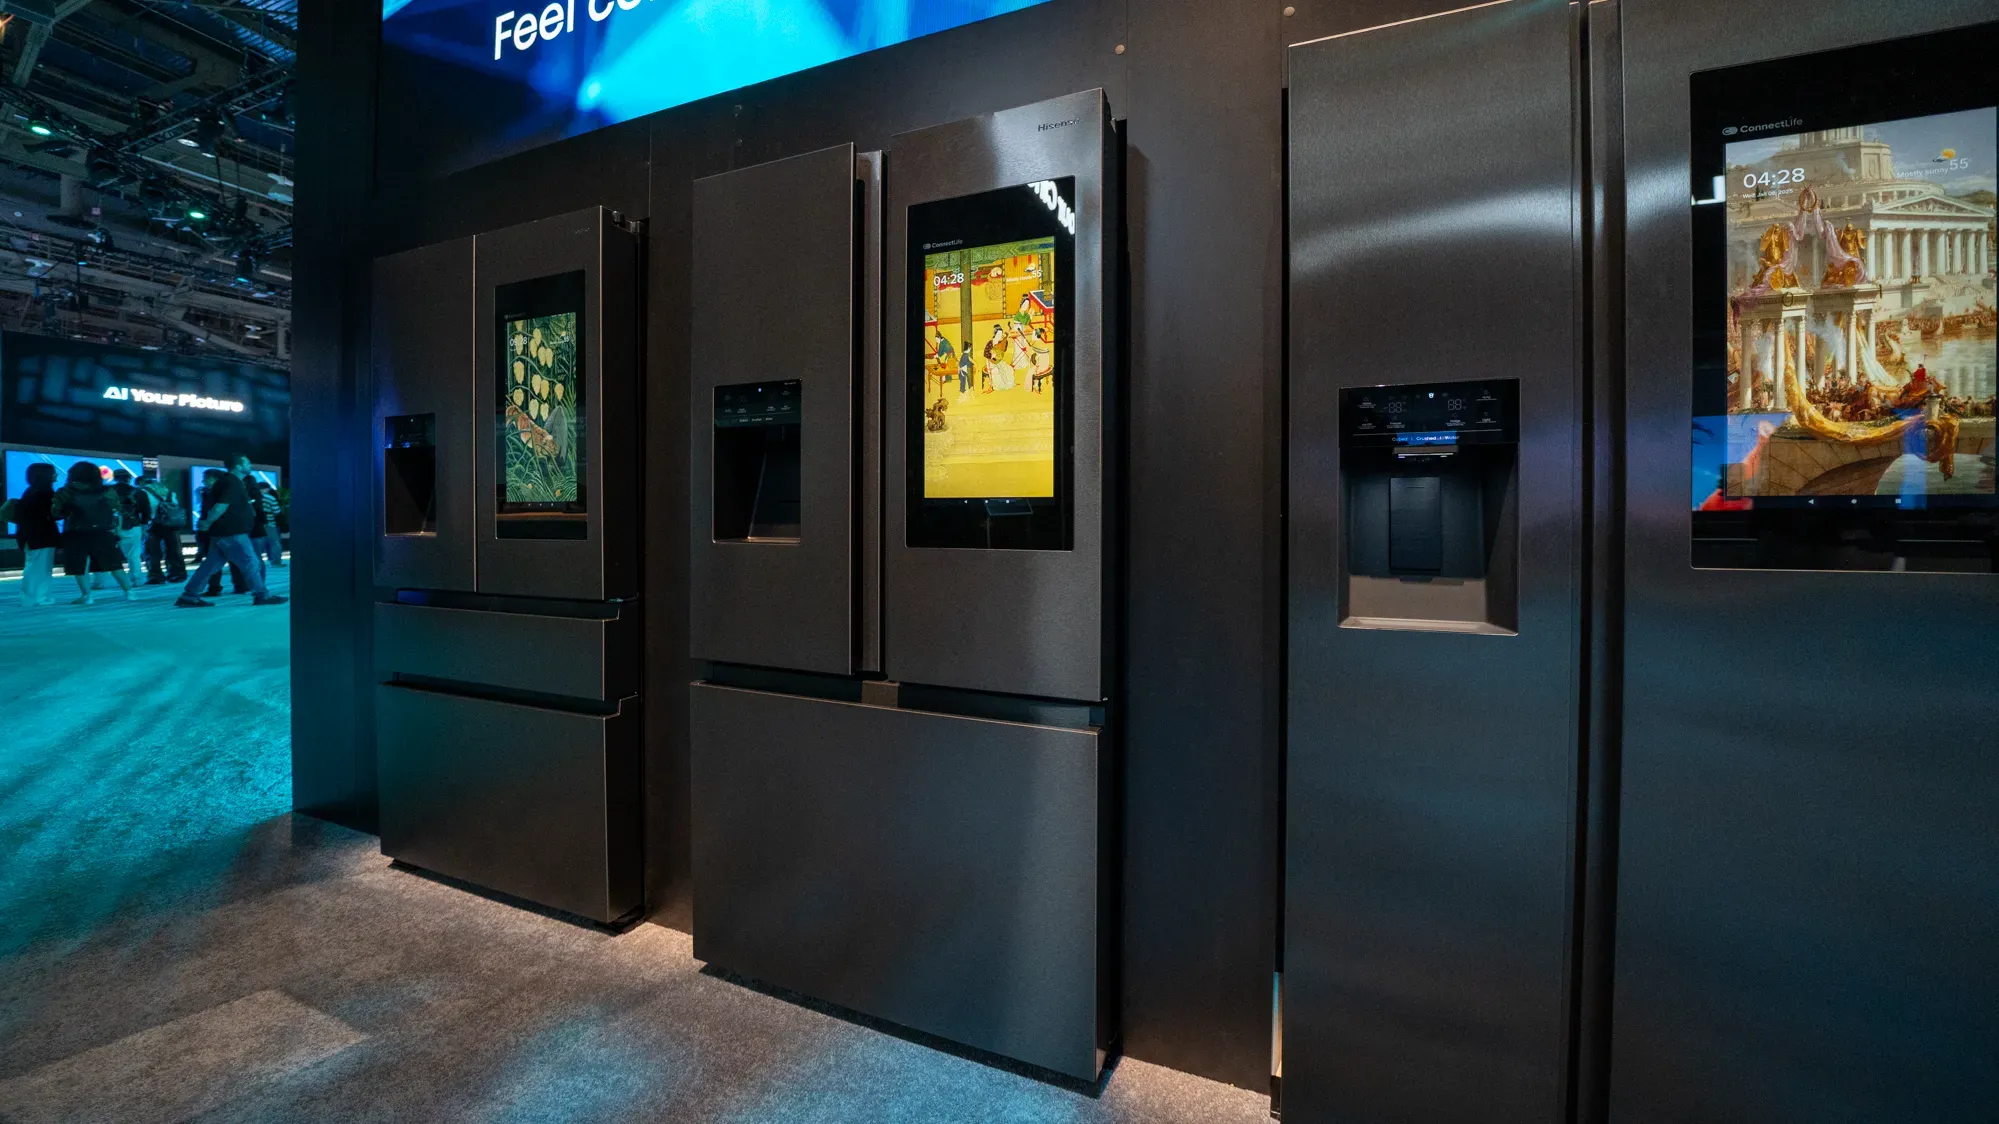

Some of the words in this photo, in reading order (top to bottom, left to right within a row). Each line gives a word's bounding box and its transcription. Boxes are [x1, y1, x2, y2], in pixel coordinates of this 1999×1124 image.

[494, 0, 575, 60] Feel
[1037, 118, 1080, 132] Hisense
[1739, 118, 1804, 134] ConnectLife
[1743, 167, 1806, 188] 04:28
[1896, 169, 1924, 178] Mostly
[1924, 167, 1949, 175] sunny
[931, 238, 964, 250] ConnectLife
[933, 272, 965, 287] 04:28
[102, 386, 129, 400] AI
[130, 388, 178, 405] Your
[178, 393, 244, 412] Picture
